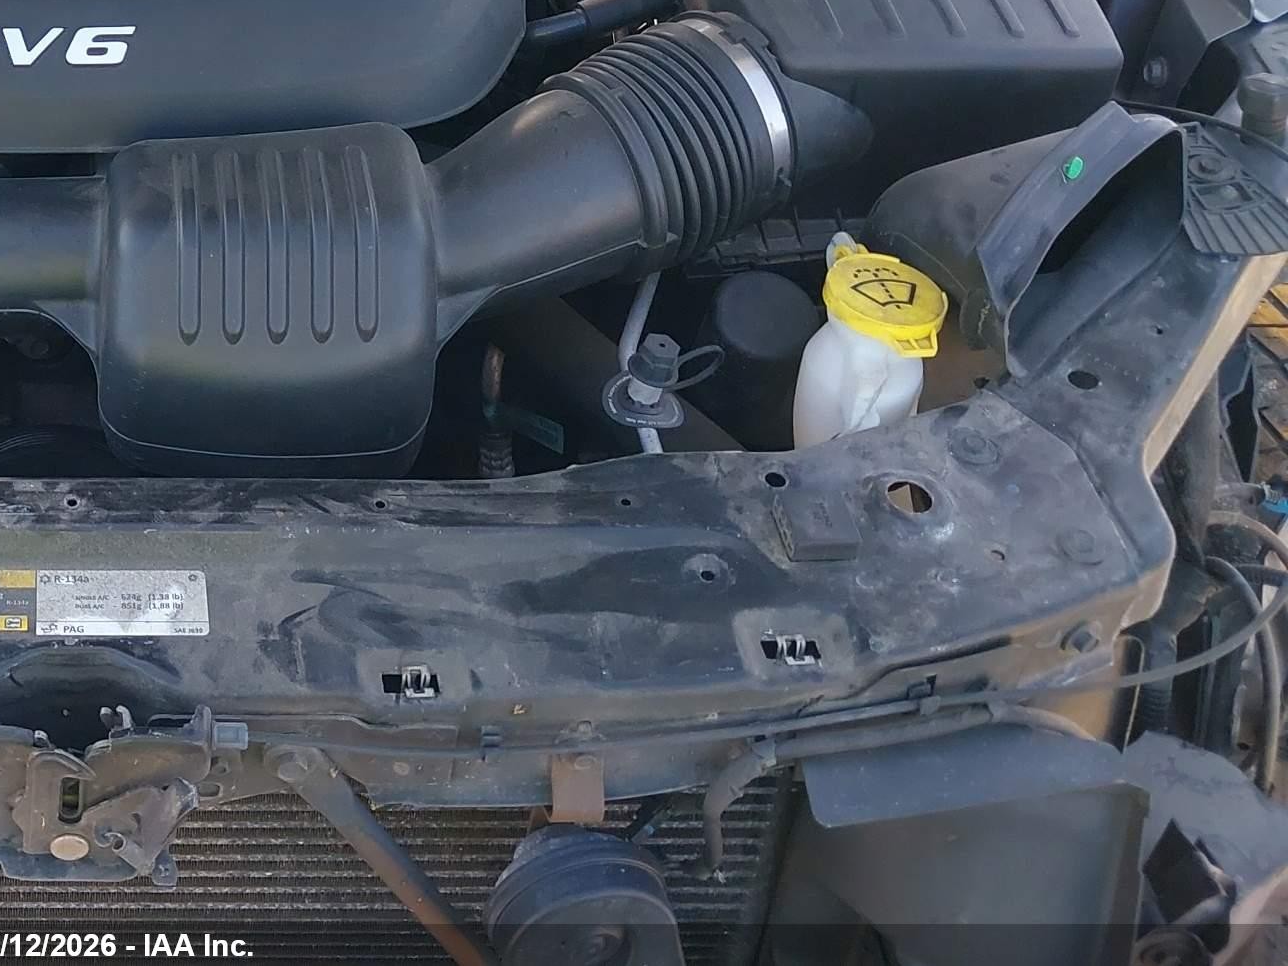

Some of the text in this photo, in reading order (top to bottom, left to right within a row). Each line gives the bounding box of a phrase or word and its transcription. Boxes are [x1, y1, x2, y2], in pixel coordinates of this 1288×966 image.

[2, 26, 136, 65] V6
[54, 575, 90, 584] R-134a
[121, 602, 142, 611] 851g
[63, 625, 85, 634] PAG
